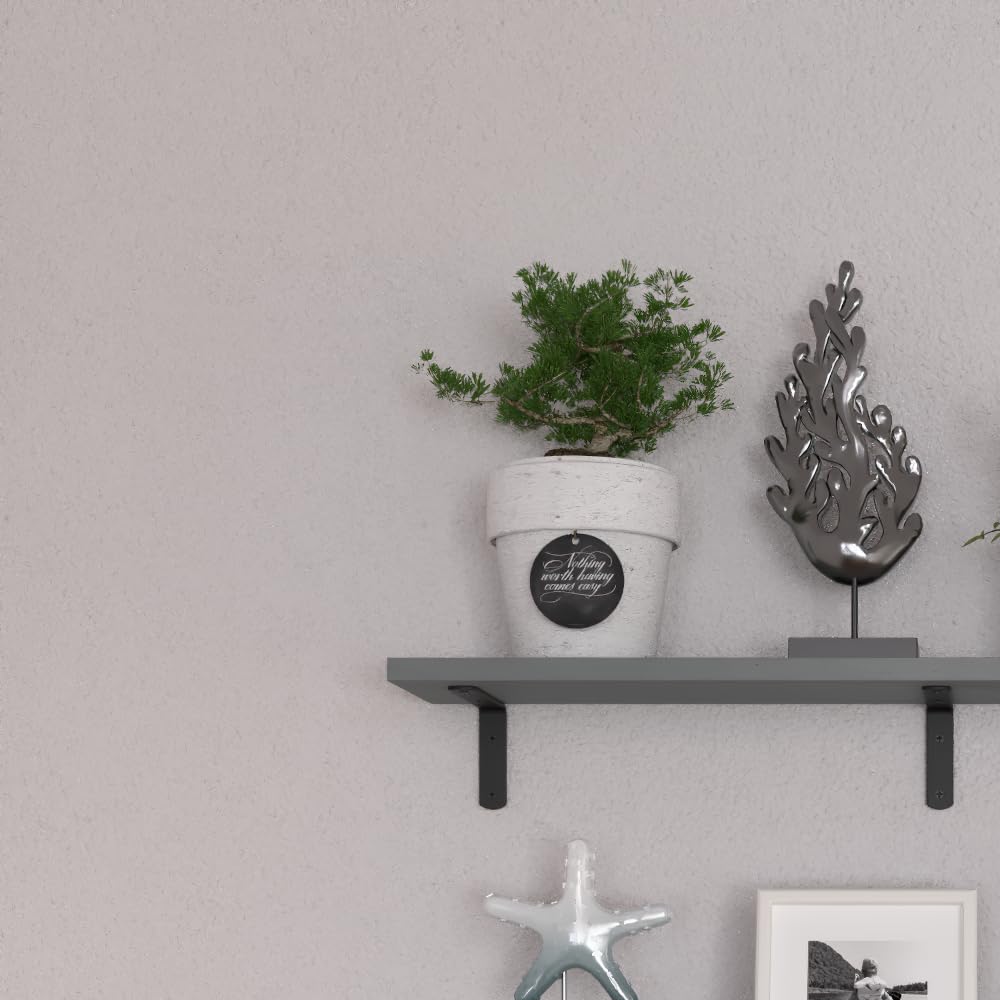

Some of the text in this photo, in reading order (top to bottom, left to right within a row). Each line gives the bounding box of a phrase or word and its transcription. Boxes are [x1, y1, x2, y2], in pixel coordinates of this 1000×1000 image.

[541, 563, 614, 587] worth having
[544, 582, 601, 598] comes easy
